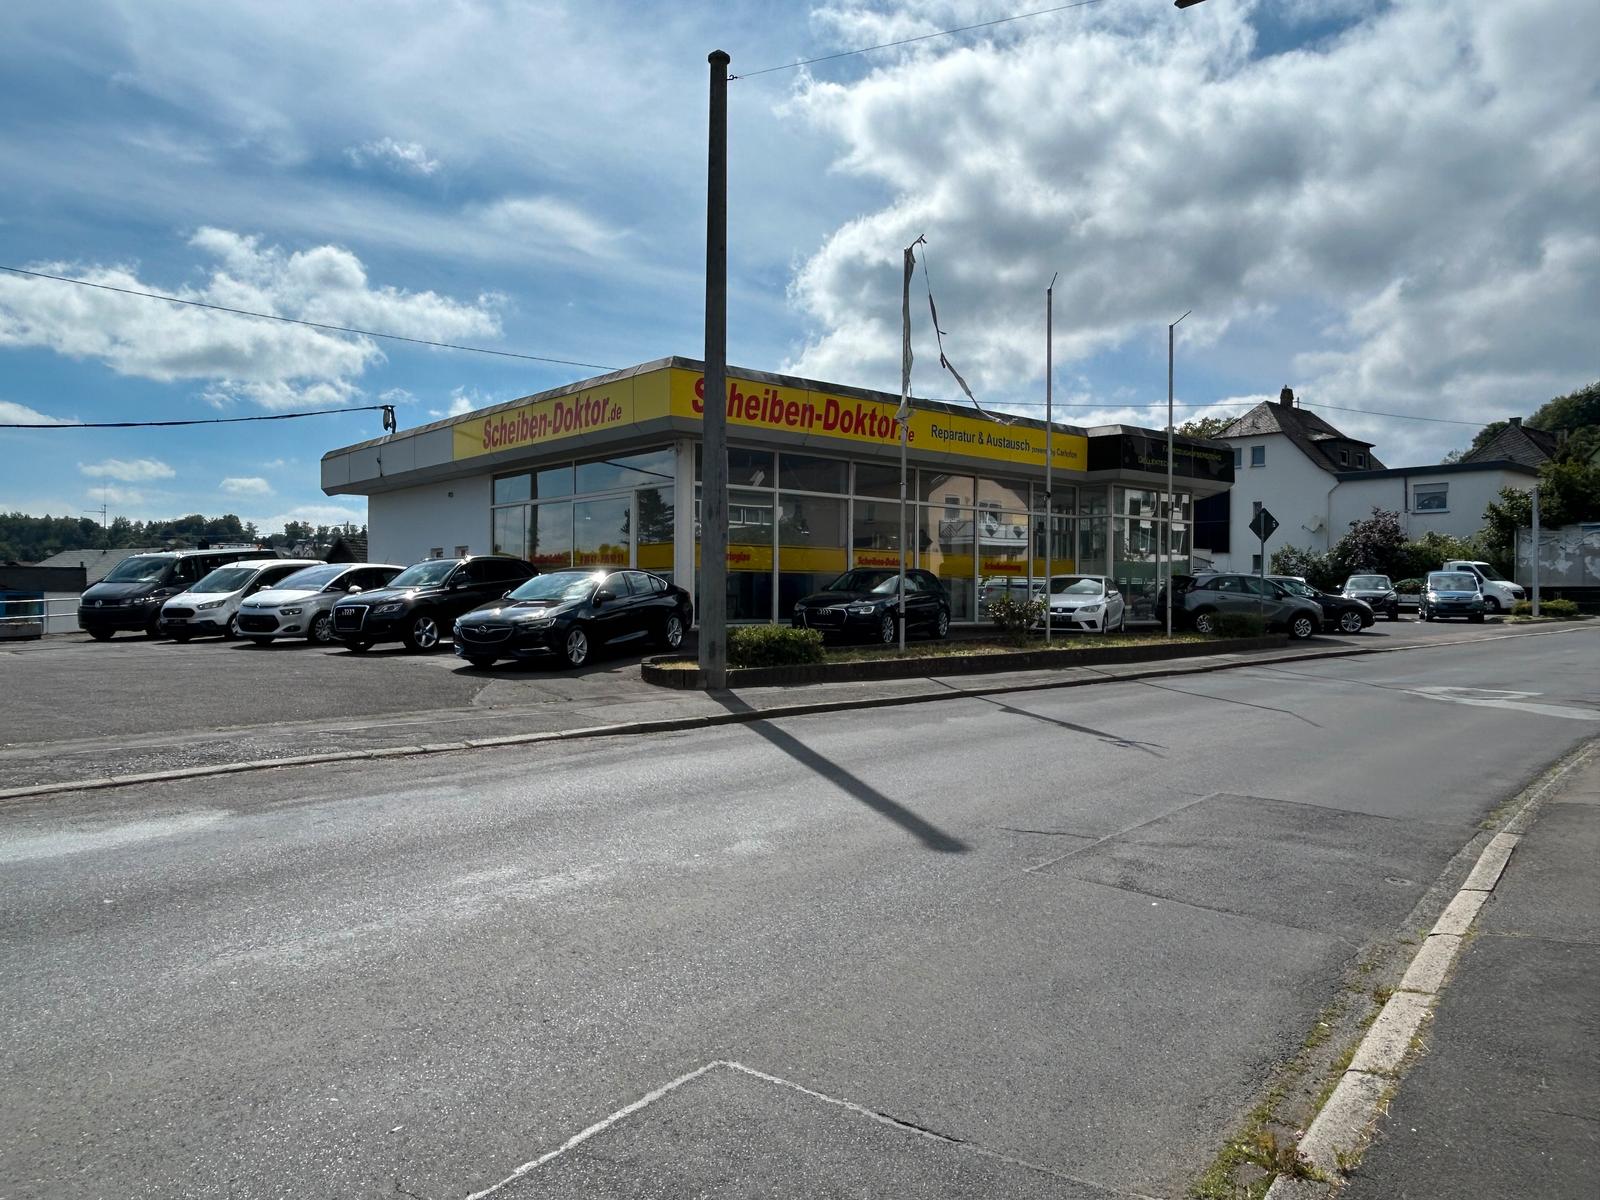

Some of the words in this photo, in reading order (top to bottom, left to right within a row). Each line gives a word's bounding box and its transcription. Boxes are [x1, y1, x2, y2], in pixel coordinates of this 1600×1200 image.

[482, 396, 622, 449] Scheiben-Doktor.de
[931, 424, 975, 444] Reparatur
[977, 432, 984, 445] &
[986, 433, 1031, 452] Austausch
